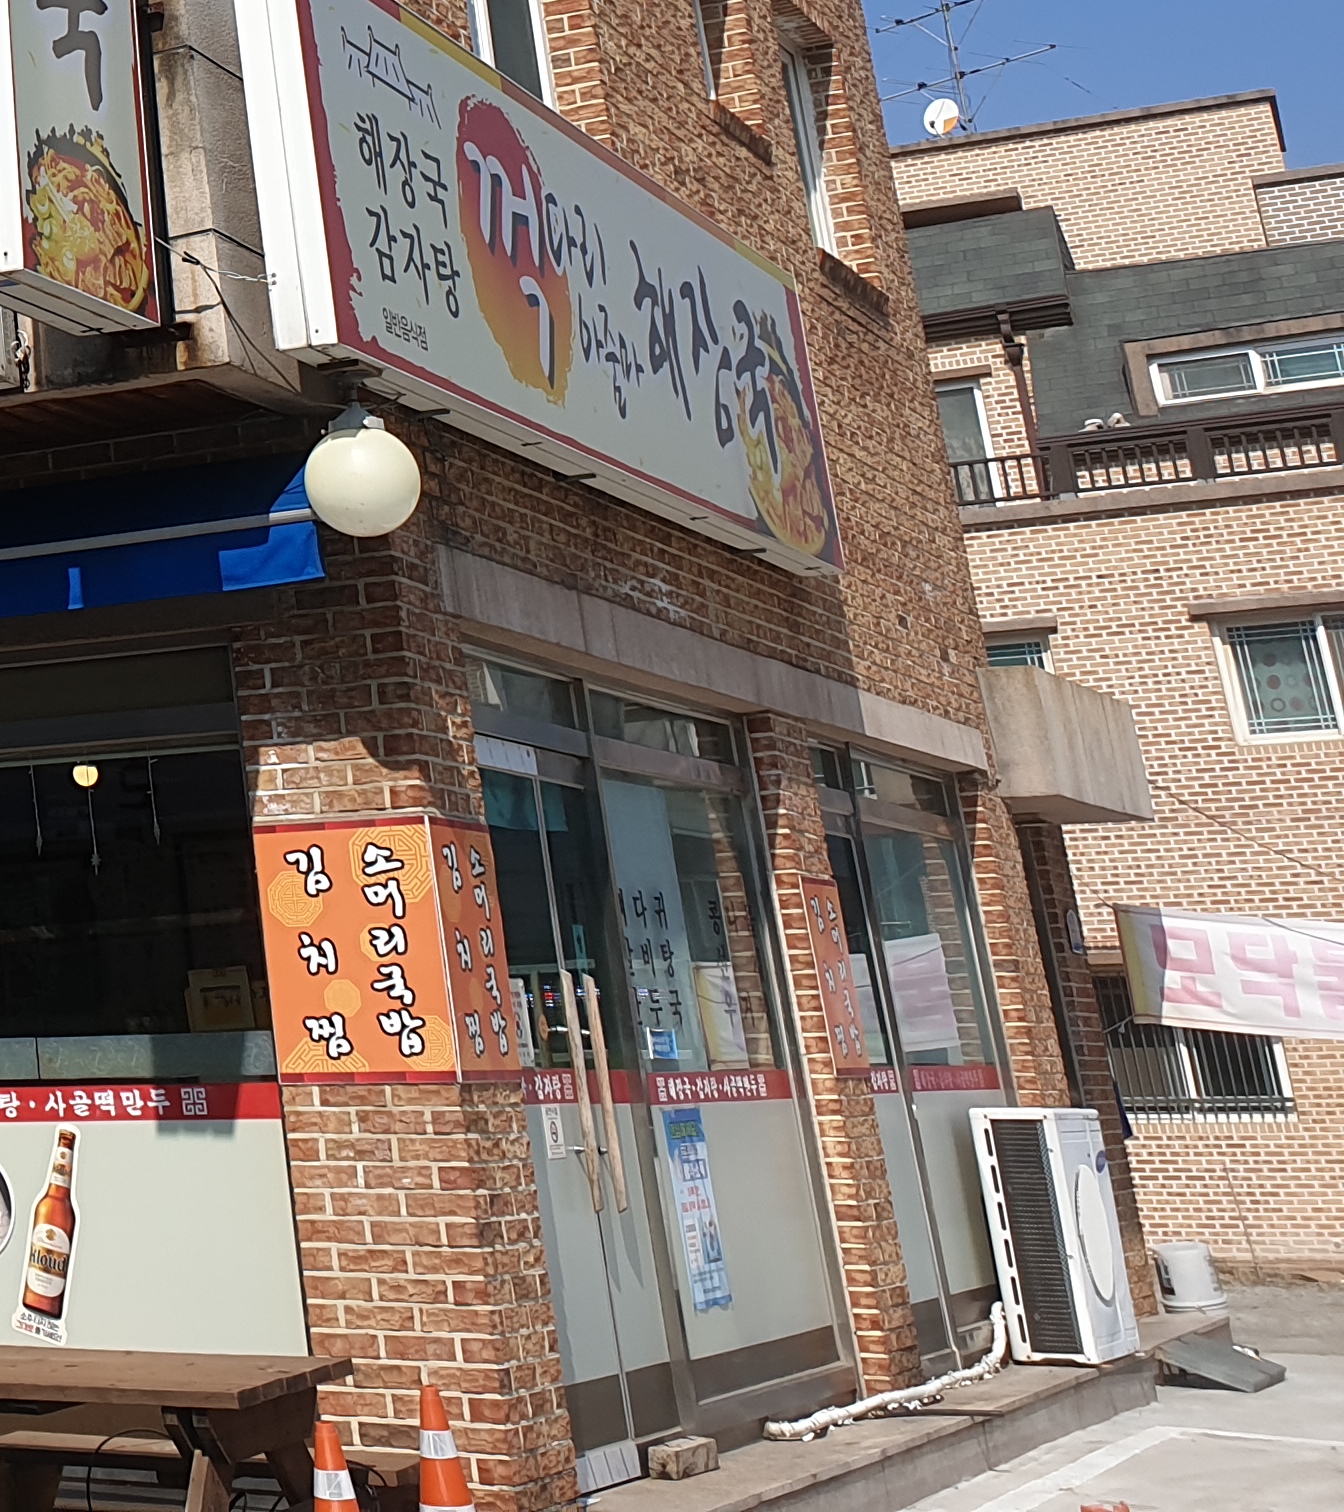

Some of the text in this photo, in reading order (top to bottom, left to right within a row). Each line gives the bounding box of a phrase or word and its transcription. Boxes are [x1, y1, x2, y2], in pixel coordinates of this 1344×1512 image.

[353, 111, 449, 228] 해장국
[366, 205, 461, 319] 감자탕
[381, 306, 429, 352] 일반음식점
[579, 290, 644, 421] 아줌마
[630, 240, 781, 473] 해장국
[285, 843, 353, 1059] 김치찜
[362, 842, 425, 1056] 소머리국밥
[442, 842, 485, 1057] 김치찜
[469, 845, 508, 1055] 소머리국밥
[618, 888, 668, 929] 다귀
[45, 1088, 170, 1117] 사골떡만두
